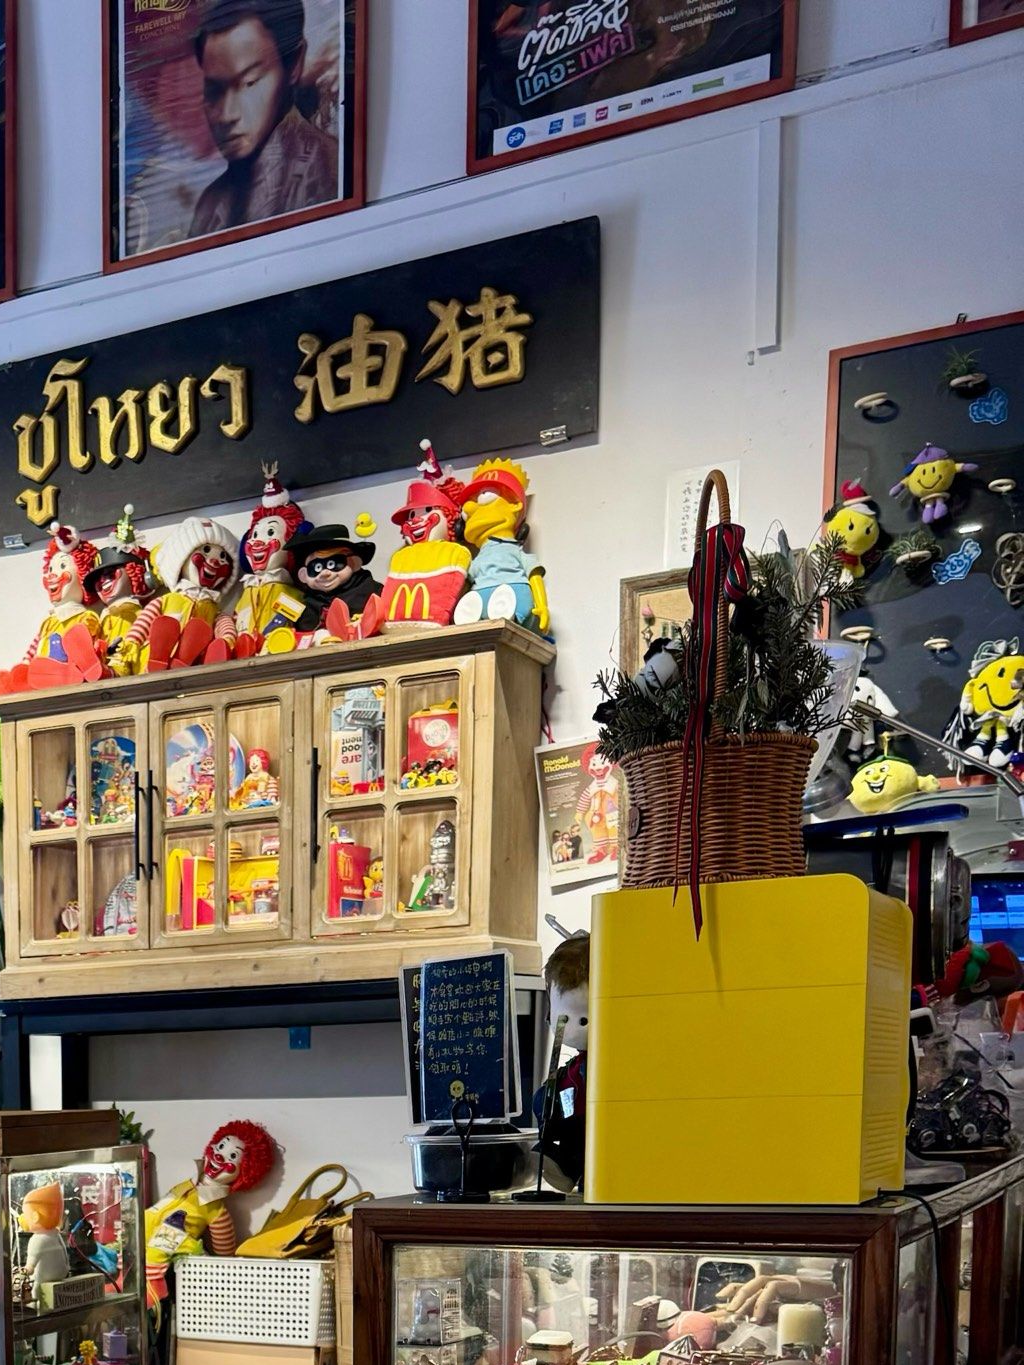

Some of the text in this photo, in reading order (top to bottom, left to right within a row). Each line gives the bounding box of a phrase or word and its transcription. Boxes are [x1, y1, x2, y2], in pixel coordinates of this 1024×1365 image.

[341, 744, 361, 755] ood
[543, 755, 569, 767] Ronald
[544, 760, 581, 773] McDonald
